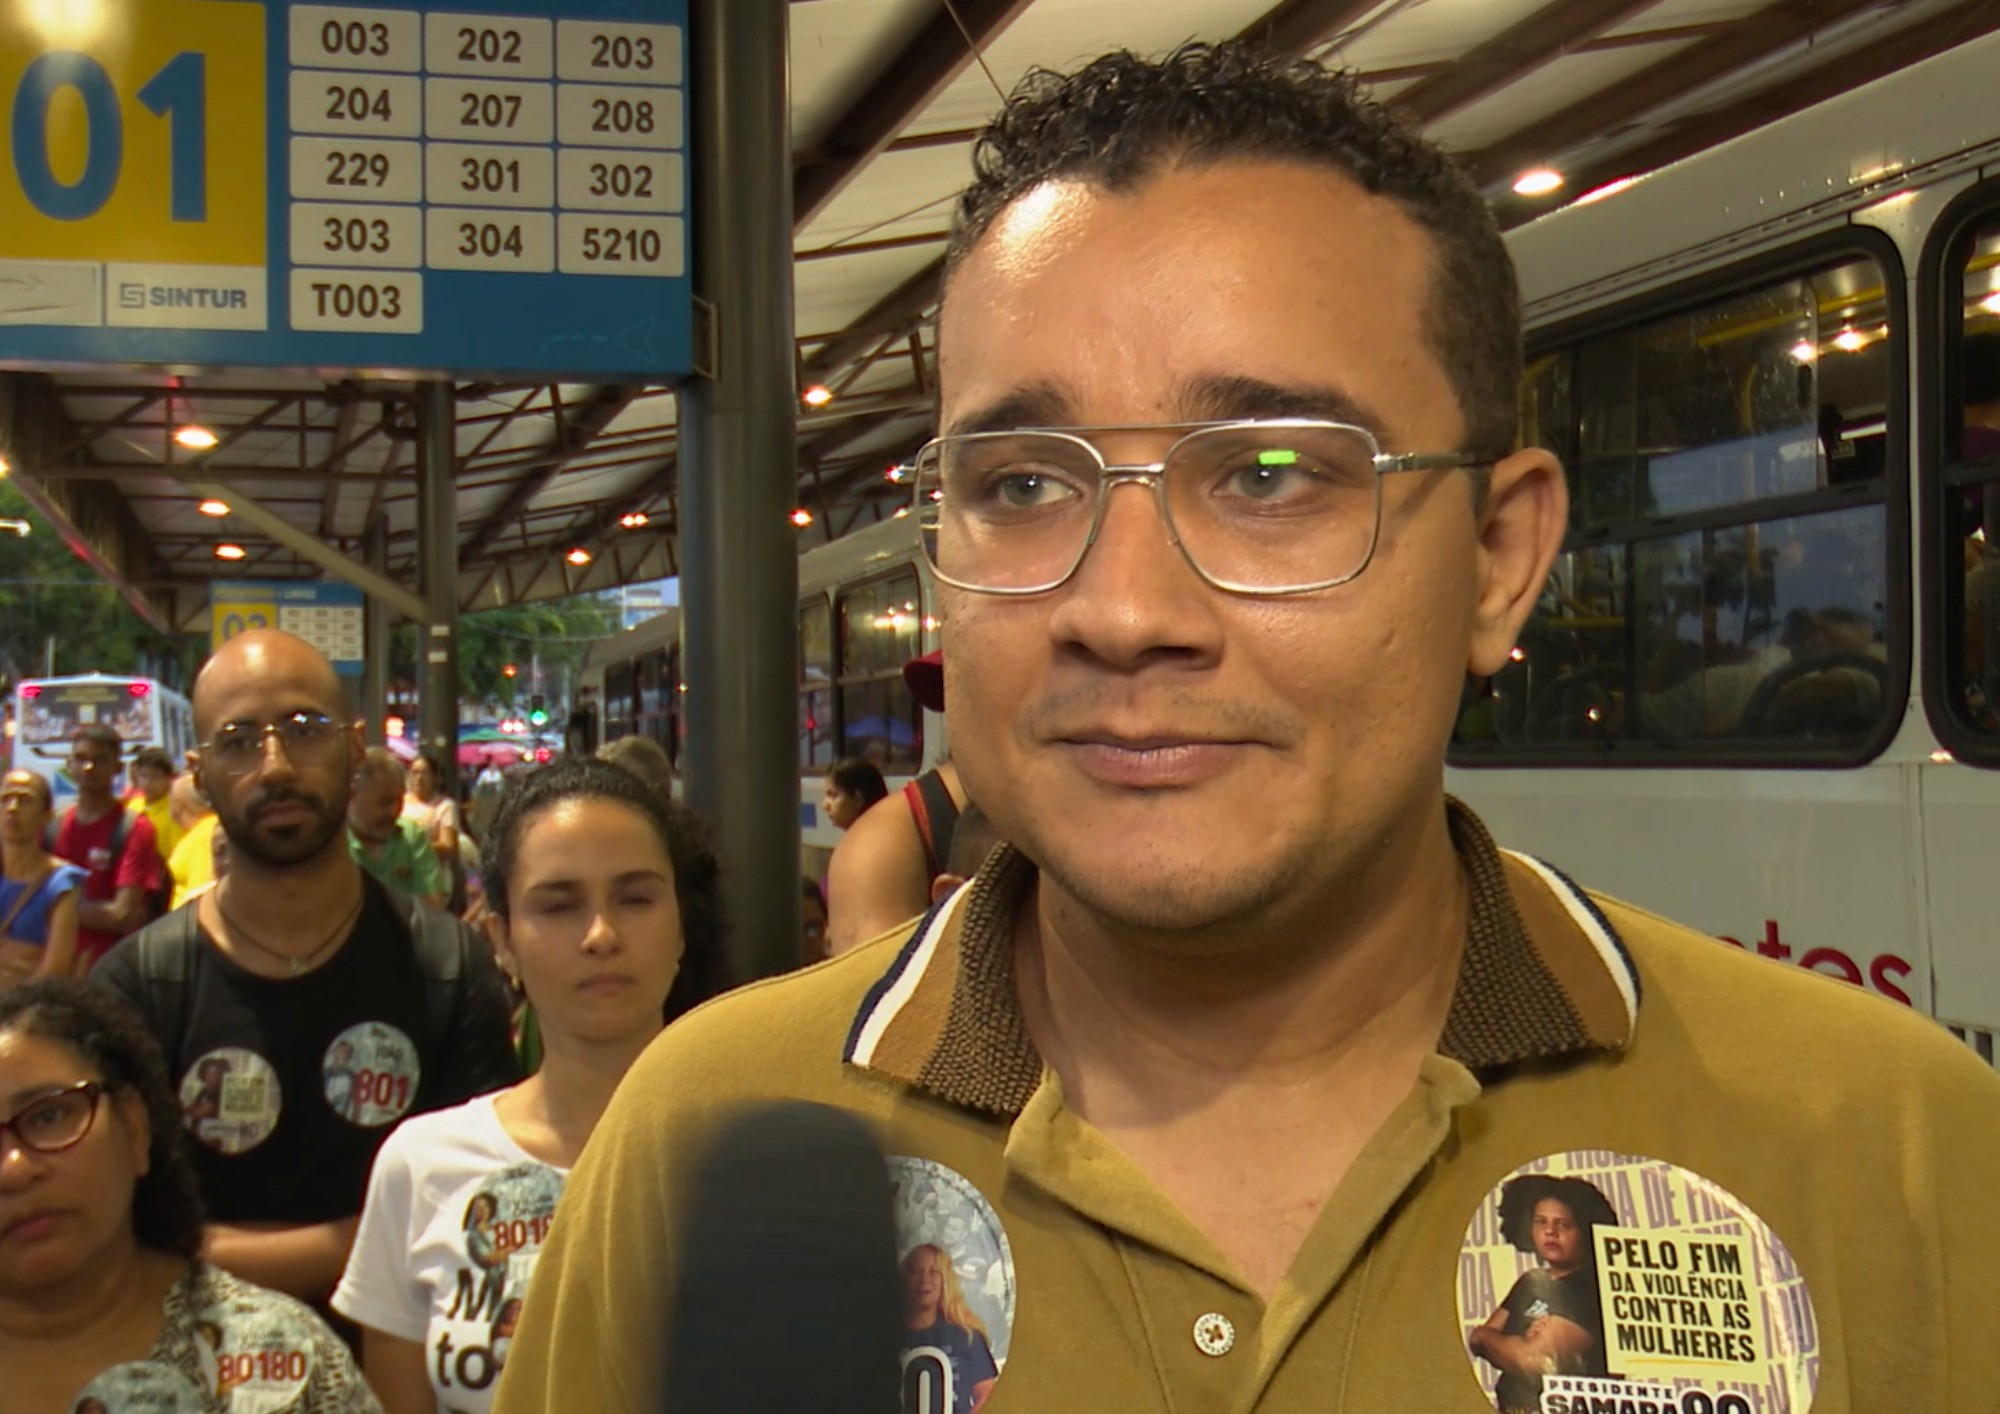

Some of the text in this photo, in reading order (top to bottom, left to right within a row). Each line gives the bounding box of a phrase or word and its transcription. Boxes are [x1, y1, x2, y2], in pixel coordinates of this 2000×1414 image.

[321, 19, 390, 57] 003
[457, 27, 522, 64] 202
[591, 34, 654, 70] 203
[326, 85, 392, 122] 204
[460, 92, 522, 128] 207
[591, 98, 655, 134] 208
[11, 49, 208, 223] 01
[326, 151, 390, 187] 229
[460, 157, 520, 193] 301
[589, 162, 653, 198] 302
[323, 217, 390, 254] 303
[458, 222, 523, 258] 304
[582, 227, 661, 263] 5210
[150, 286, 248, 309] SINTUR
[311, 283, 401, 319] T003
[354, 1067, 411, 1111] 801
[1603, 1236, 1743, 1276] PELO FIM
[1608, 1270, 1749, 1303] DA VIOLÊNCIA
[1612, 1294, 1752, 1331] CONTRA AS
[1616, 1323, 1756, 1364] MULHERES
[216, 1350, 306, 1384] 80180
[1549, 1379, 1673, 1400] PRESIDENTE
